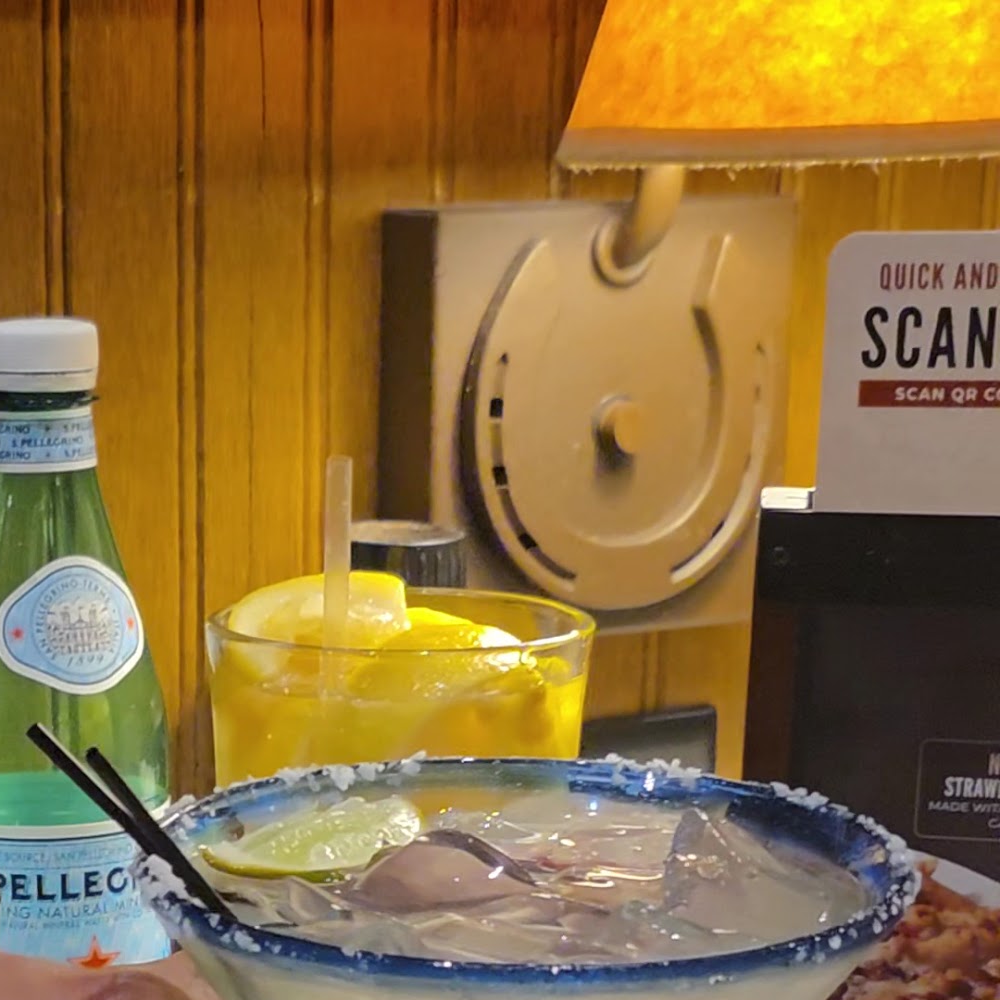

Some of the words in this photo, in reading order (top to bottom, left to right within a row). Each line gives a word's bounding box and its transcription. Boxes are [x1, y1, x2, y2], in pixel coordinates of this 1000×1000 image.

[879, 262, 945, 291] QUICK
[953, 262, 999, 290] AND
[861, 306, 998, 369] SCAN
[894, 386, 946, 401] SCAN
[950, 386, 978, 403] QR
[943, 776, 1000, 799] STRAW
[927, 801, 971, 813] MADE
[37, 900, 109, 919] NATURAL
